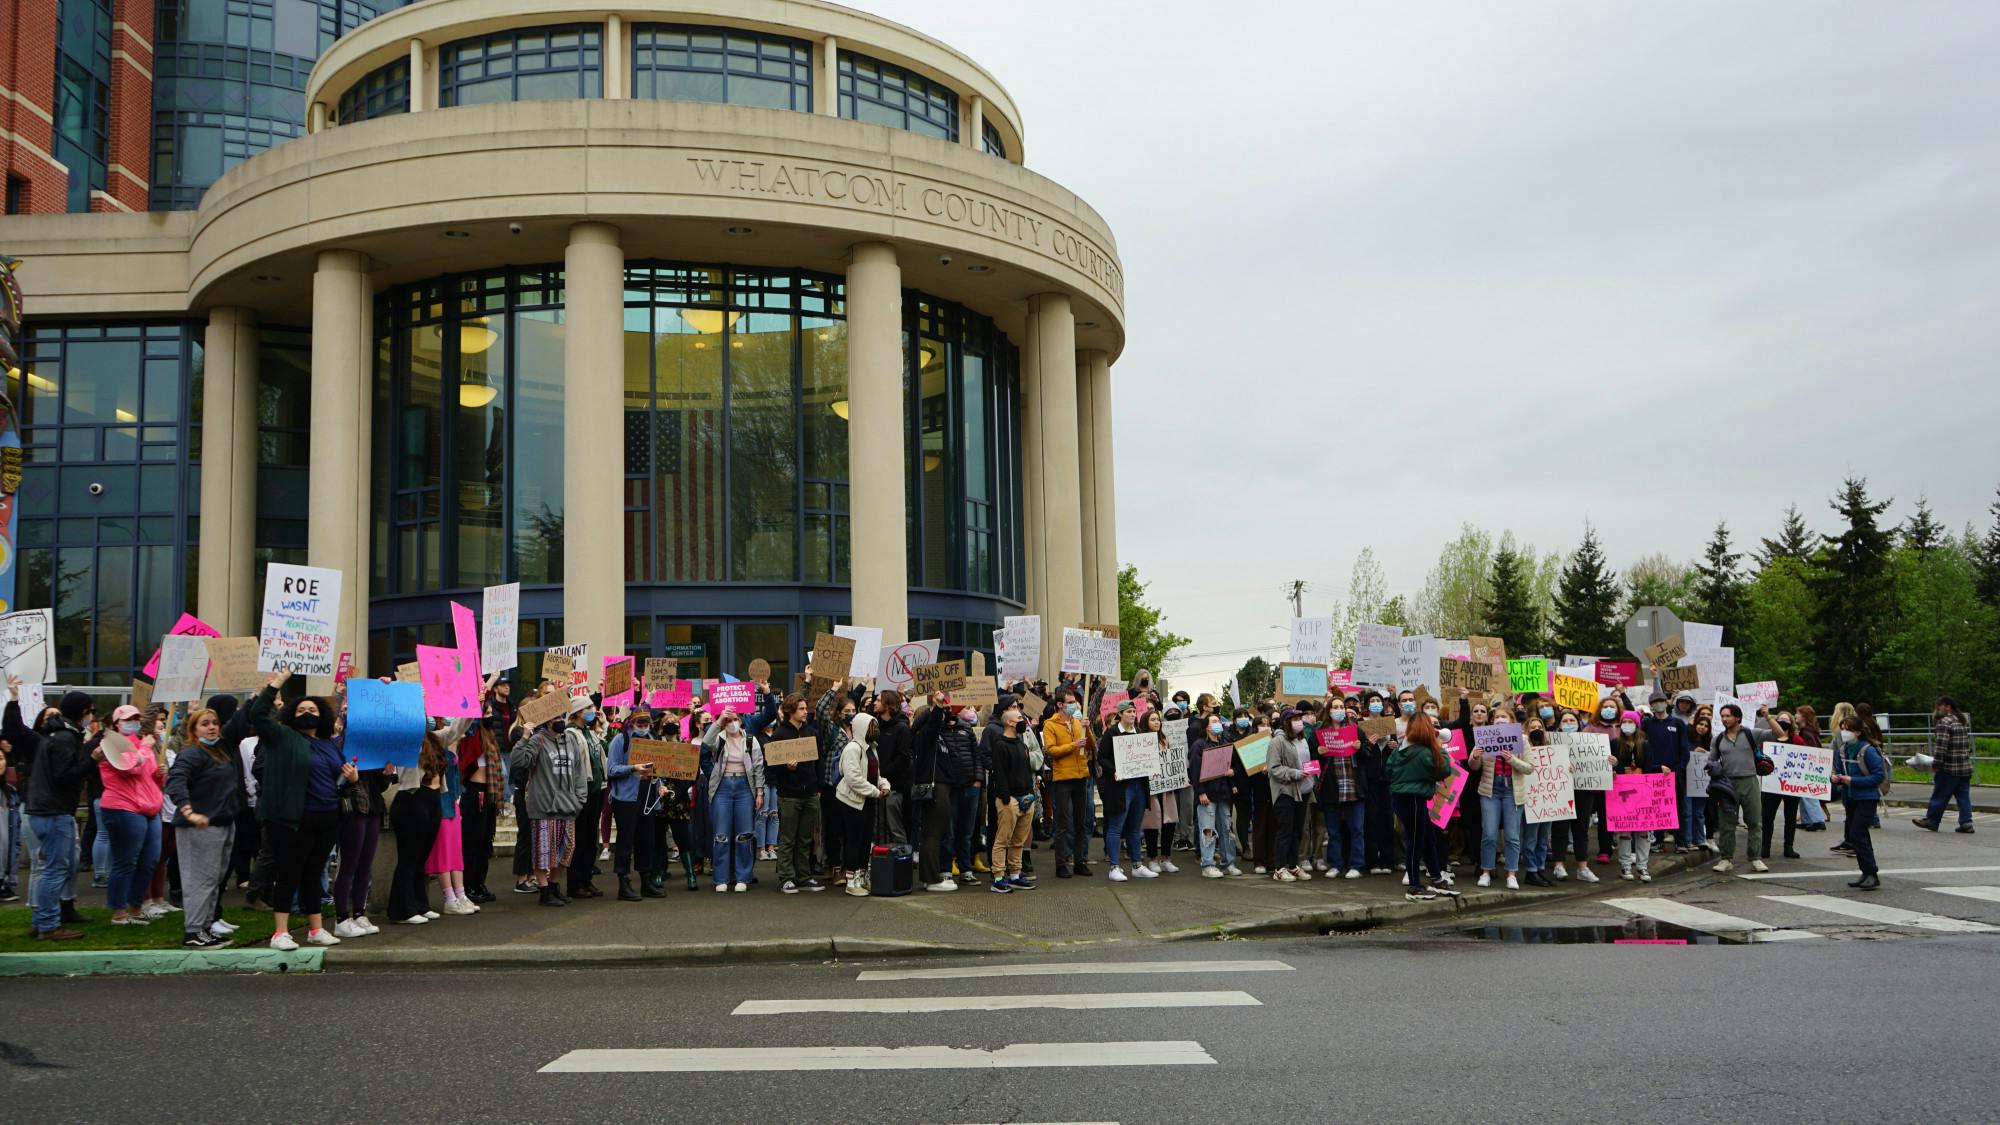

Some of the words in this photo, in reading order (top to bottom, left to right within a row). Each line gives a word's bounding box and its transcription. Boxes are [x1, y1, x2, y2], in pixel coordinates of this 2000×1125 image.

[686, 157, 907, 211] WHATCOM
[923, 187, 1043, 246] COUNTY
[284, 576, 319, 596] ROE
[296, 631, 311, 643] THE
[313, 633, 331, 644] END
[1065, 635, 1089, 647] NOT
[299, 643, 329, 654] DYING
[646, 659, 667, 667] KEEP
[1082, 659, 1116, 675] BODY
[1440, 658, 1458, 671] KEEP
[1461, 660, 1493, 677] ABORTION
[1507, 661, 1542, 676] UCTIVE
[916, 664, 940, 681] BANS
[944, 663, 960, 676] OFF
[1662, 669, 1680, 681] NOT
[1440, 671, 1458, 687] SAFE
[1464, 675, 1491, 692] LEGAL
[1510, 677, 1541, 691] NOMY
[1554, 673, 1563, 685] IS
[1563, 677, 1569, 687] A
[1571, 677, 1598, 693] HUMAN
[916, 682, 935, 695] OUR
[715, 696, 749, 704] ABORTION
[1559, 688, 1593, 710] RIGHT
[1476, 728, 1501, 737] BANS
[1477, 737, 1496, 745] OFF
[1497, 735, 1518, 743] OUR
[1577, 745, 1607, 758] HAVE
[1533, 764, 1570, 781] YOUR
[1652, 778, 1671, 788] HOPE
[1542, 792, 1558, 804] MY
